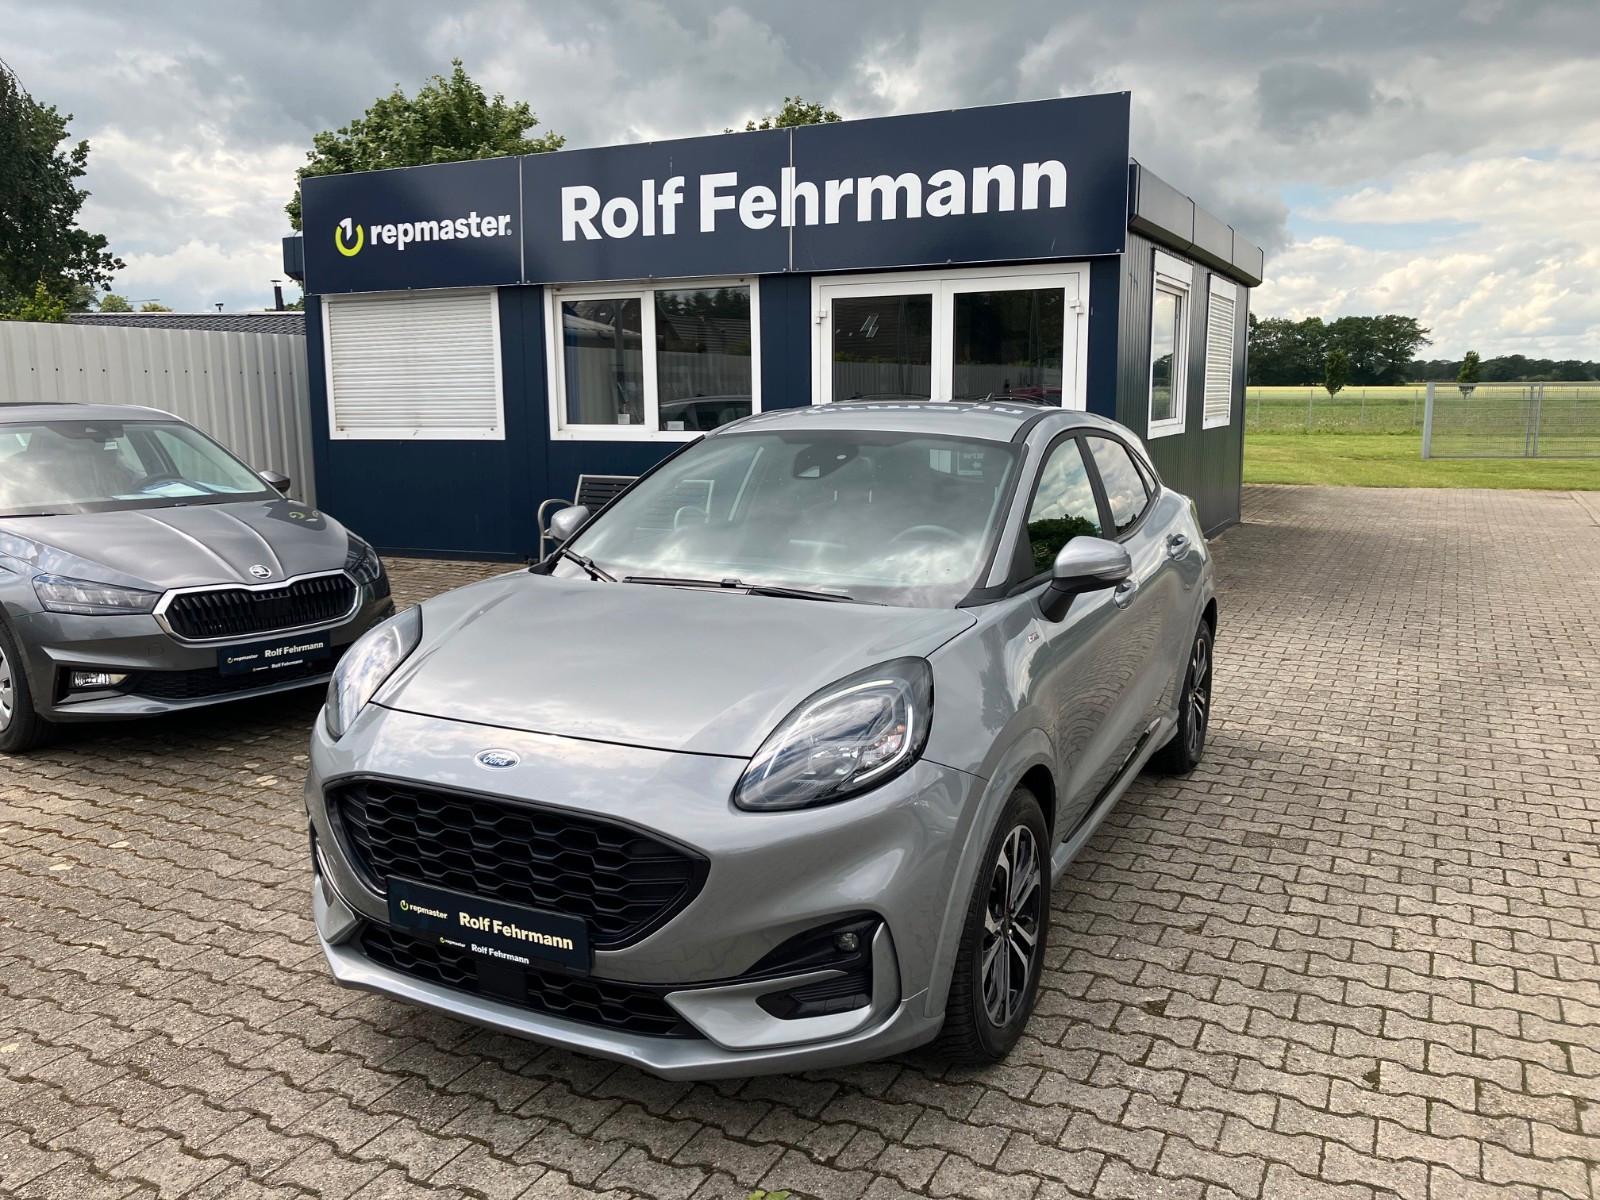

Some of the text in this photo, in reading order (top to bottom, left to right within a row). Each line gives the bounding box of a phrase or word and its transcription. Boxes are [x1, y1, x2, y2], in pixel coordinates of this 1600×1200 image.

[561, 159, 1067, 241] Rolf Fehrmann
[264, 647, 283, 658] Rolf
[283, 642, 324, 655] Fehrmann
[409, 904, 574, 950] repmaster Rolf Fehrmann
[471, 943, 488, 955] Rolf
[488, 947, 530, 965] Fehrmann
